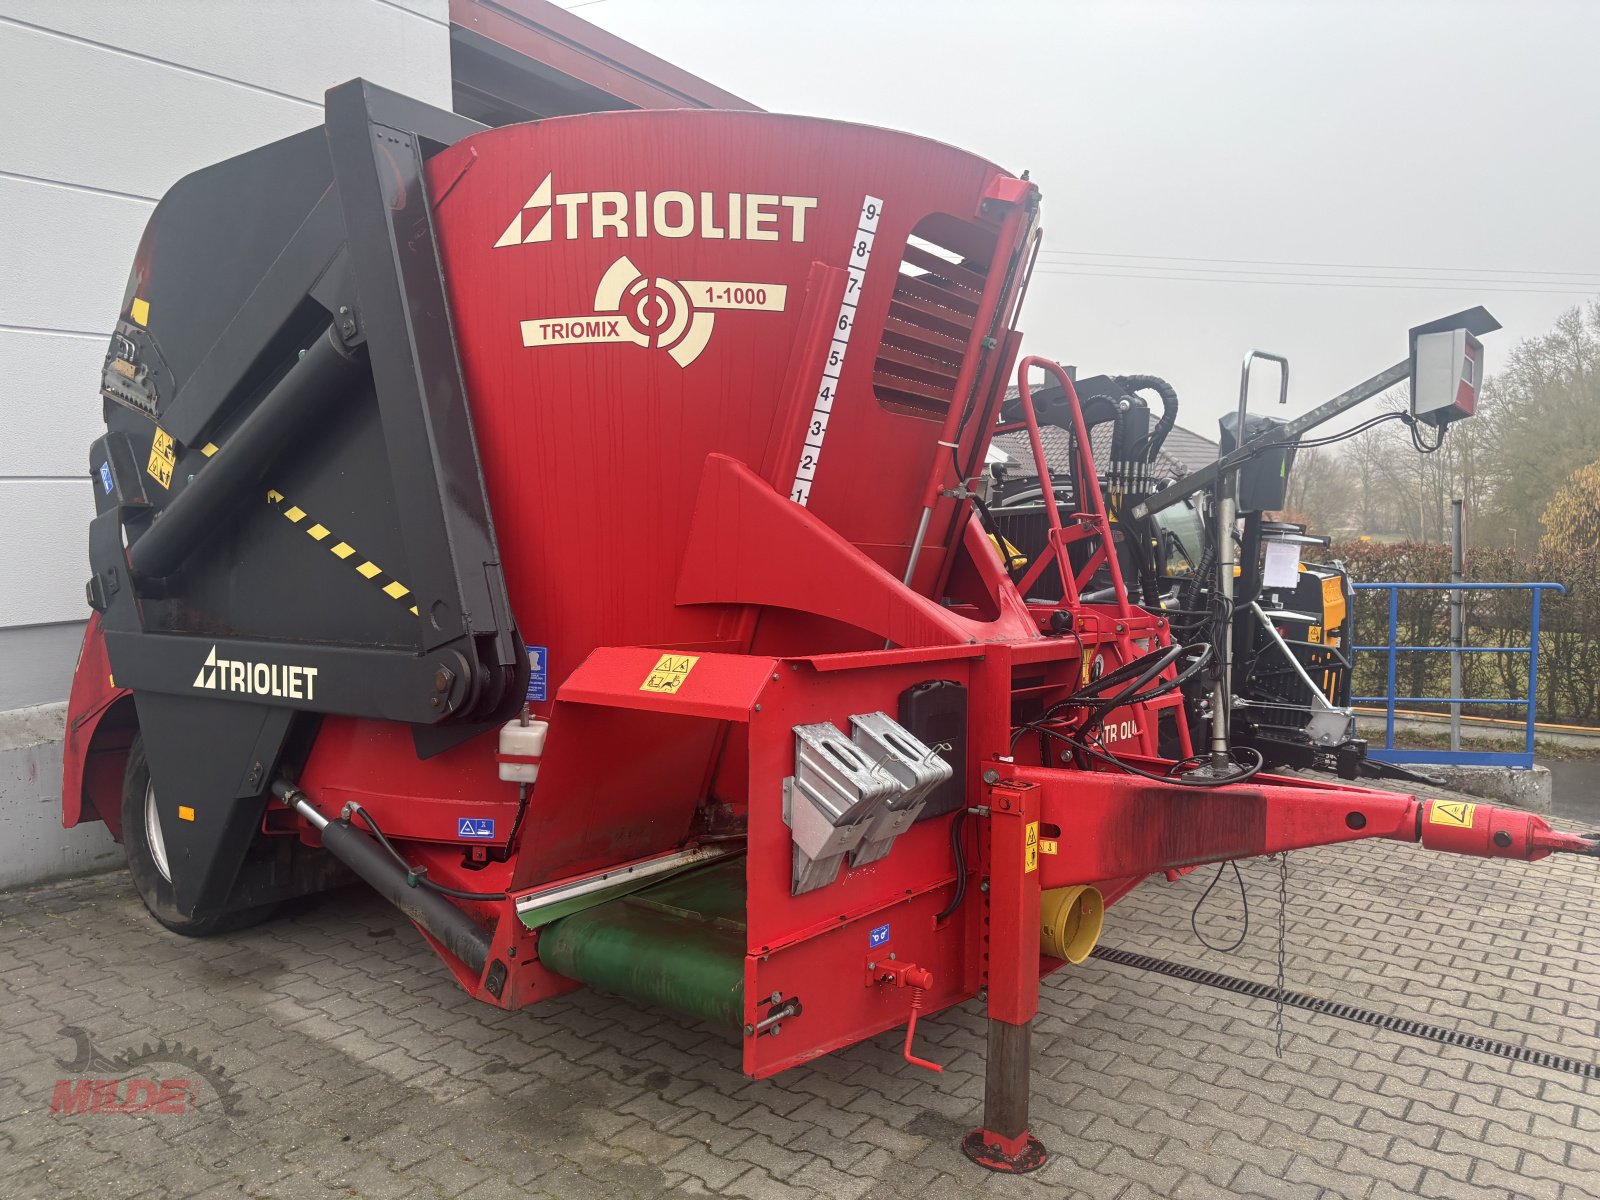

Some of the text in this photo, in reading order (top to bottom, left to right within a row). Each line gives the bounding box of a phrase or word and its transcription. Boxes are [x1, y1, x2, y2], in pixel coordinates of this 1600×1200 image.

[556, 190, 818, 243] TRIOLIET
[865, 204, 876, 220] 9
[856, 241, 867, 257] 8
[705, 286, 767, 305] 1-1000
[838, 314, 848, 330] 6
[539, 321, 620, 341] TRIOMIX
[829, 351, 840, 366] 5
[820, 387, 830, 401] 4
[811, 421, 822, 436] 3
[802, 455, 813, 470] 2
[217, 659, 318, 700] TRIOLIET
